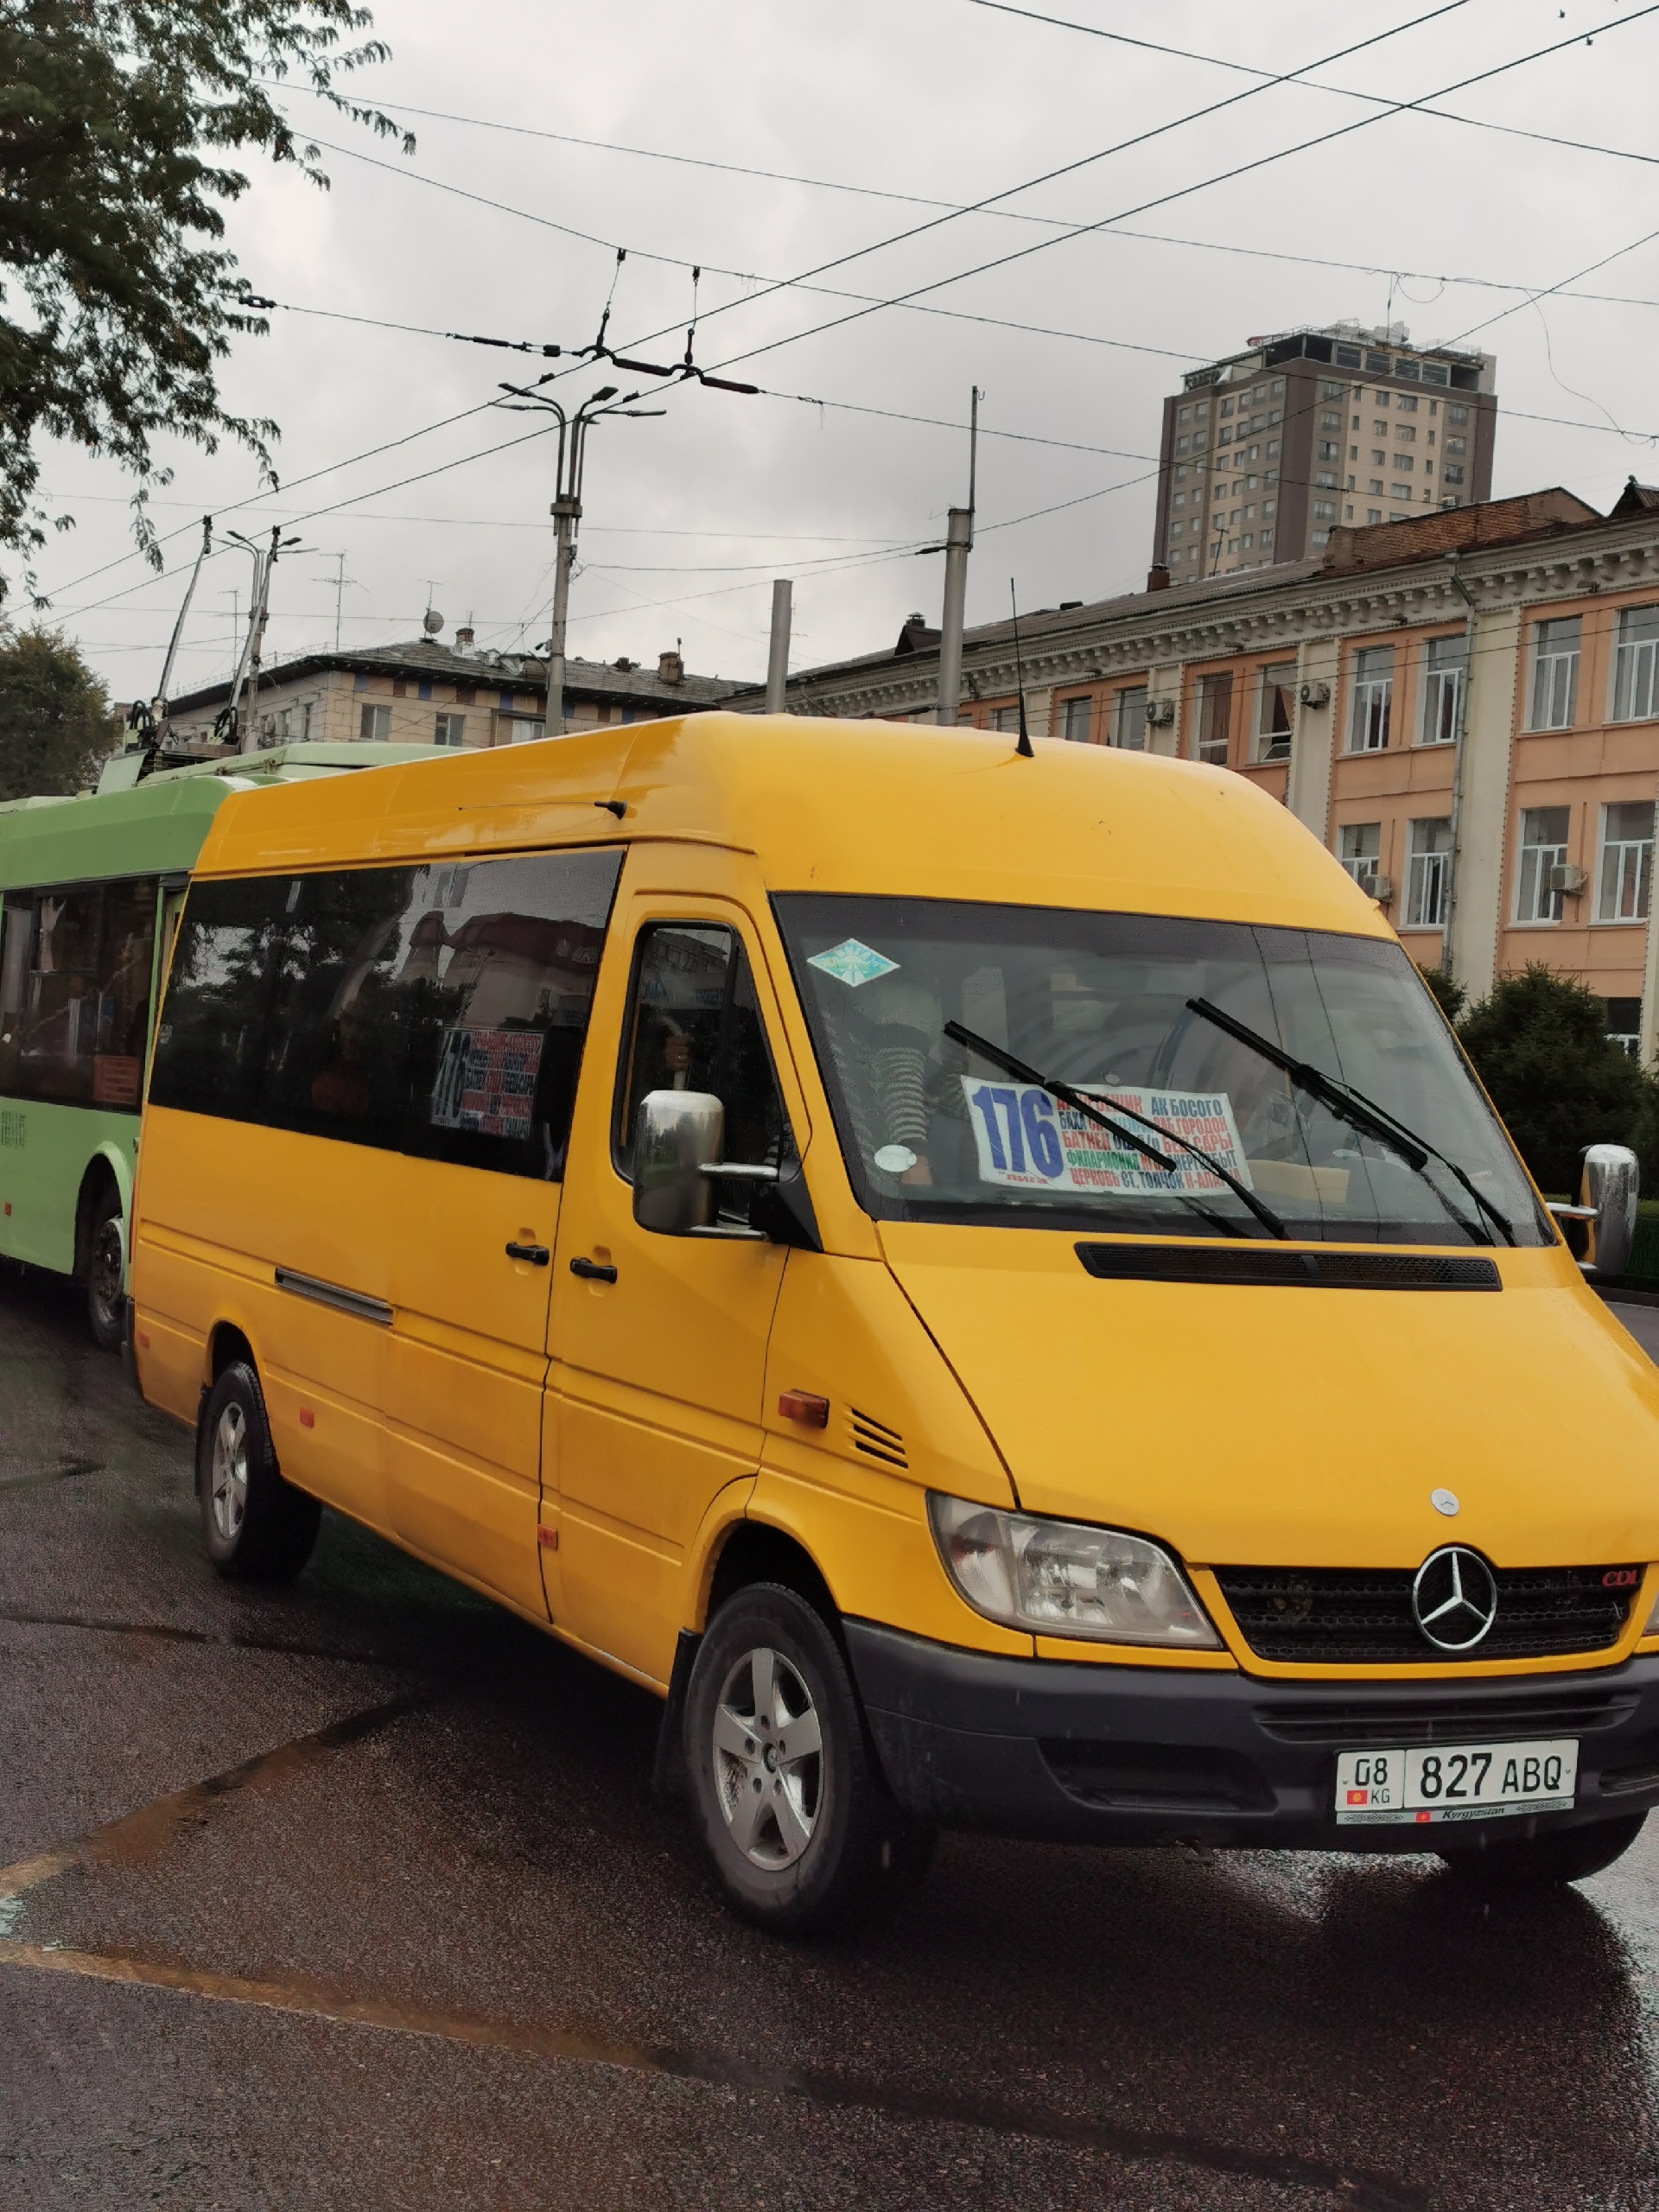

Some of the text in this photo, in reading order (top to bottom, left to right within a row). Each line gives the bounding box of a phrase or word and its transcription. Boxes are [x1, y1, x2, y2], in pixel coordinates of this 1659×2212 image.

[1151, 1096, 1168, 1116] АК
[1170, 1099, 1223, 1117] БОСОГО
[972, 1086, 1064, 1179] 176
[1062, 1131, 1111, 1151] БАТКЕН
[1192, 1130, 1234, 1153] САРЫ
[1066, 1149, 1140, 1171] ФИЛАРМОНИЯ
[1071, 1167, 1121, 1187] ЦЕРКОВЬ
[1184, 1167, 1244, 1189] Н-АЛАА
[1602, 1569, 1637, 1586] CDI
[1420, 1752, 1492, 1799] 827
[1502, 1755, 1562, 1795] ABQ
[1370, 1789, 1390, 1805] KG
[1441, 1808, 1505, 1821] Kyrgyzstan
